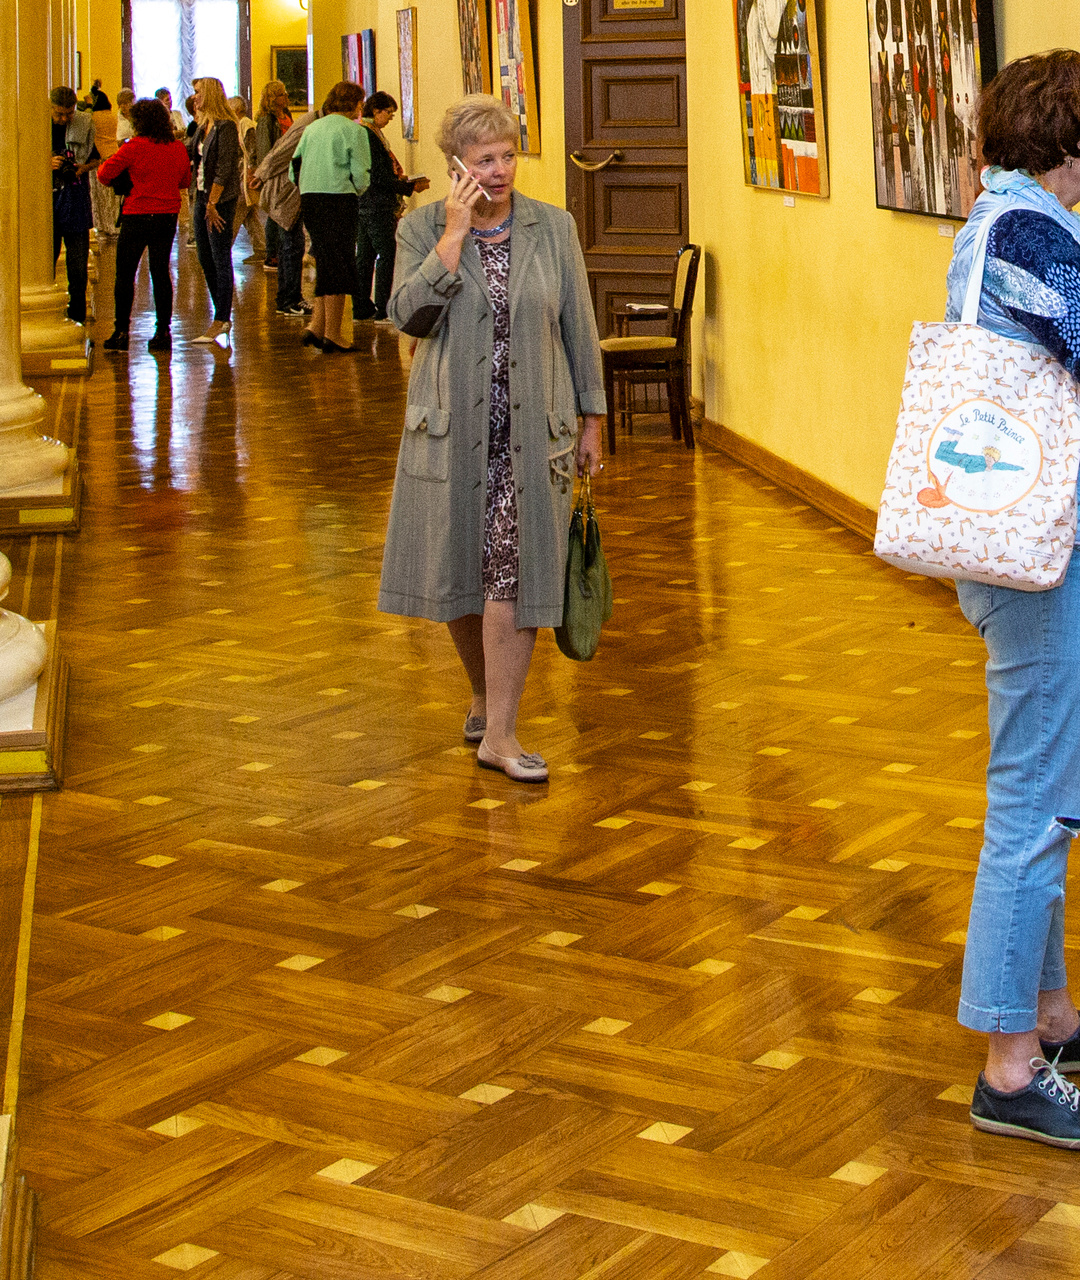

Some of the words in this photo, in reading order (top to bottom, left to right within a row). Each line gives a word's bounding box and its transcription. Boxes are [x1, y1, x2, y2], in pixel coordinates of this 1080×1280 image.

[959, 413, 970, 427] Le
[973, 408, 996, 425] Petit
[997, 417, 1026, 444] Prince
